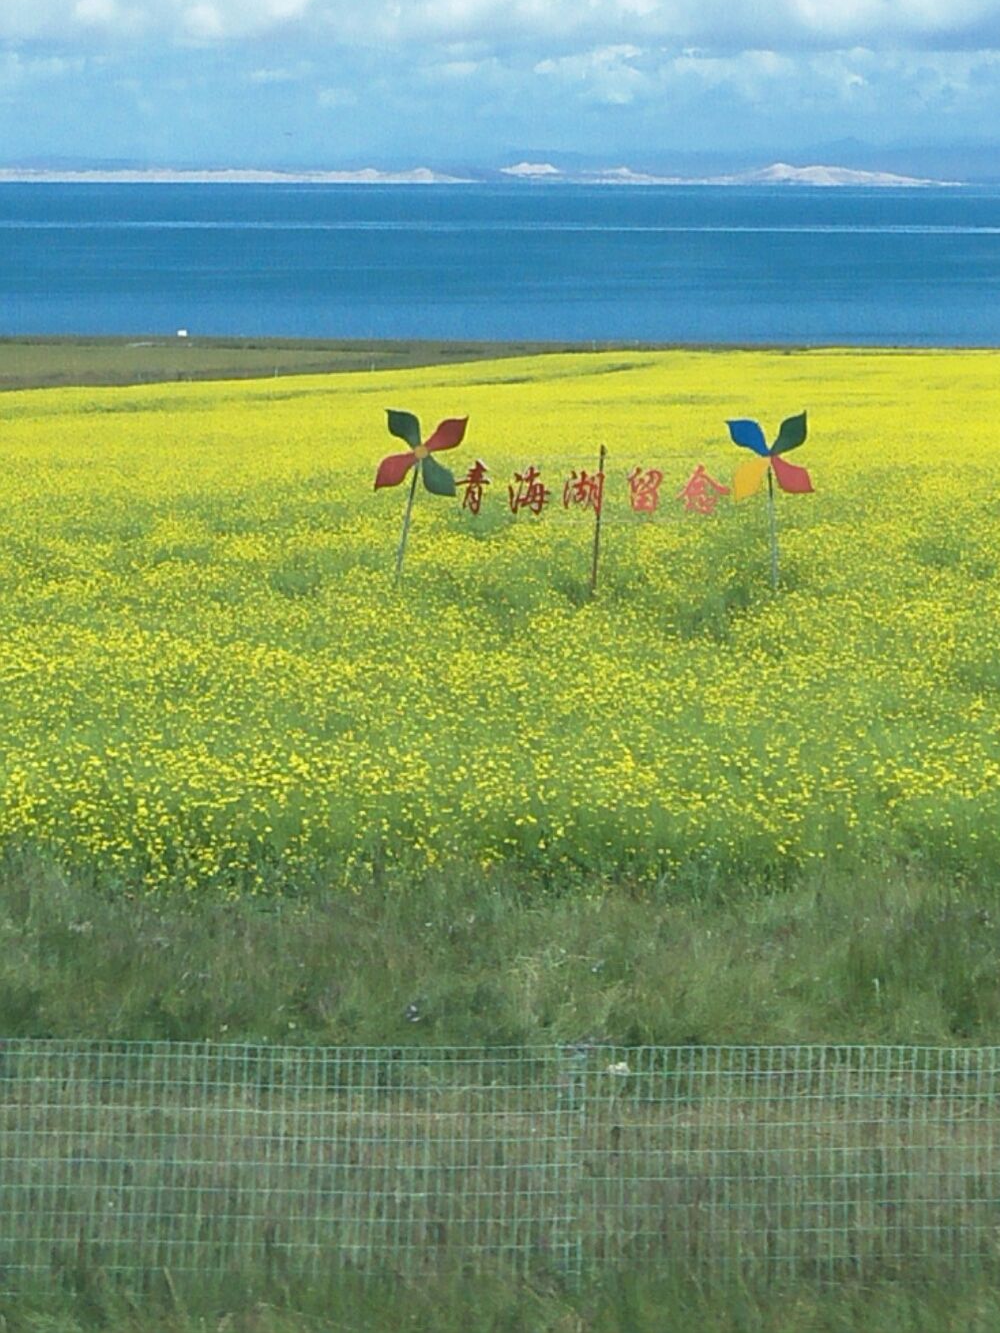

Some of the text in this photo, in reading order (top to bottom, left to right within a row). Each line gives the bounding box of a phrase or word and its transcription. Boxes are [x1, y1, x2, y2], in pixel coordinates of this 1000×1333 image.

[455, 459, 730, 515] 青海湖留念
